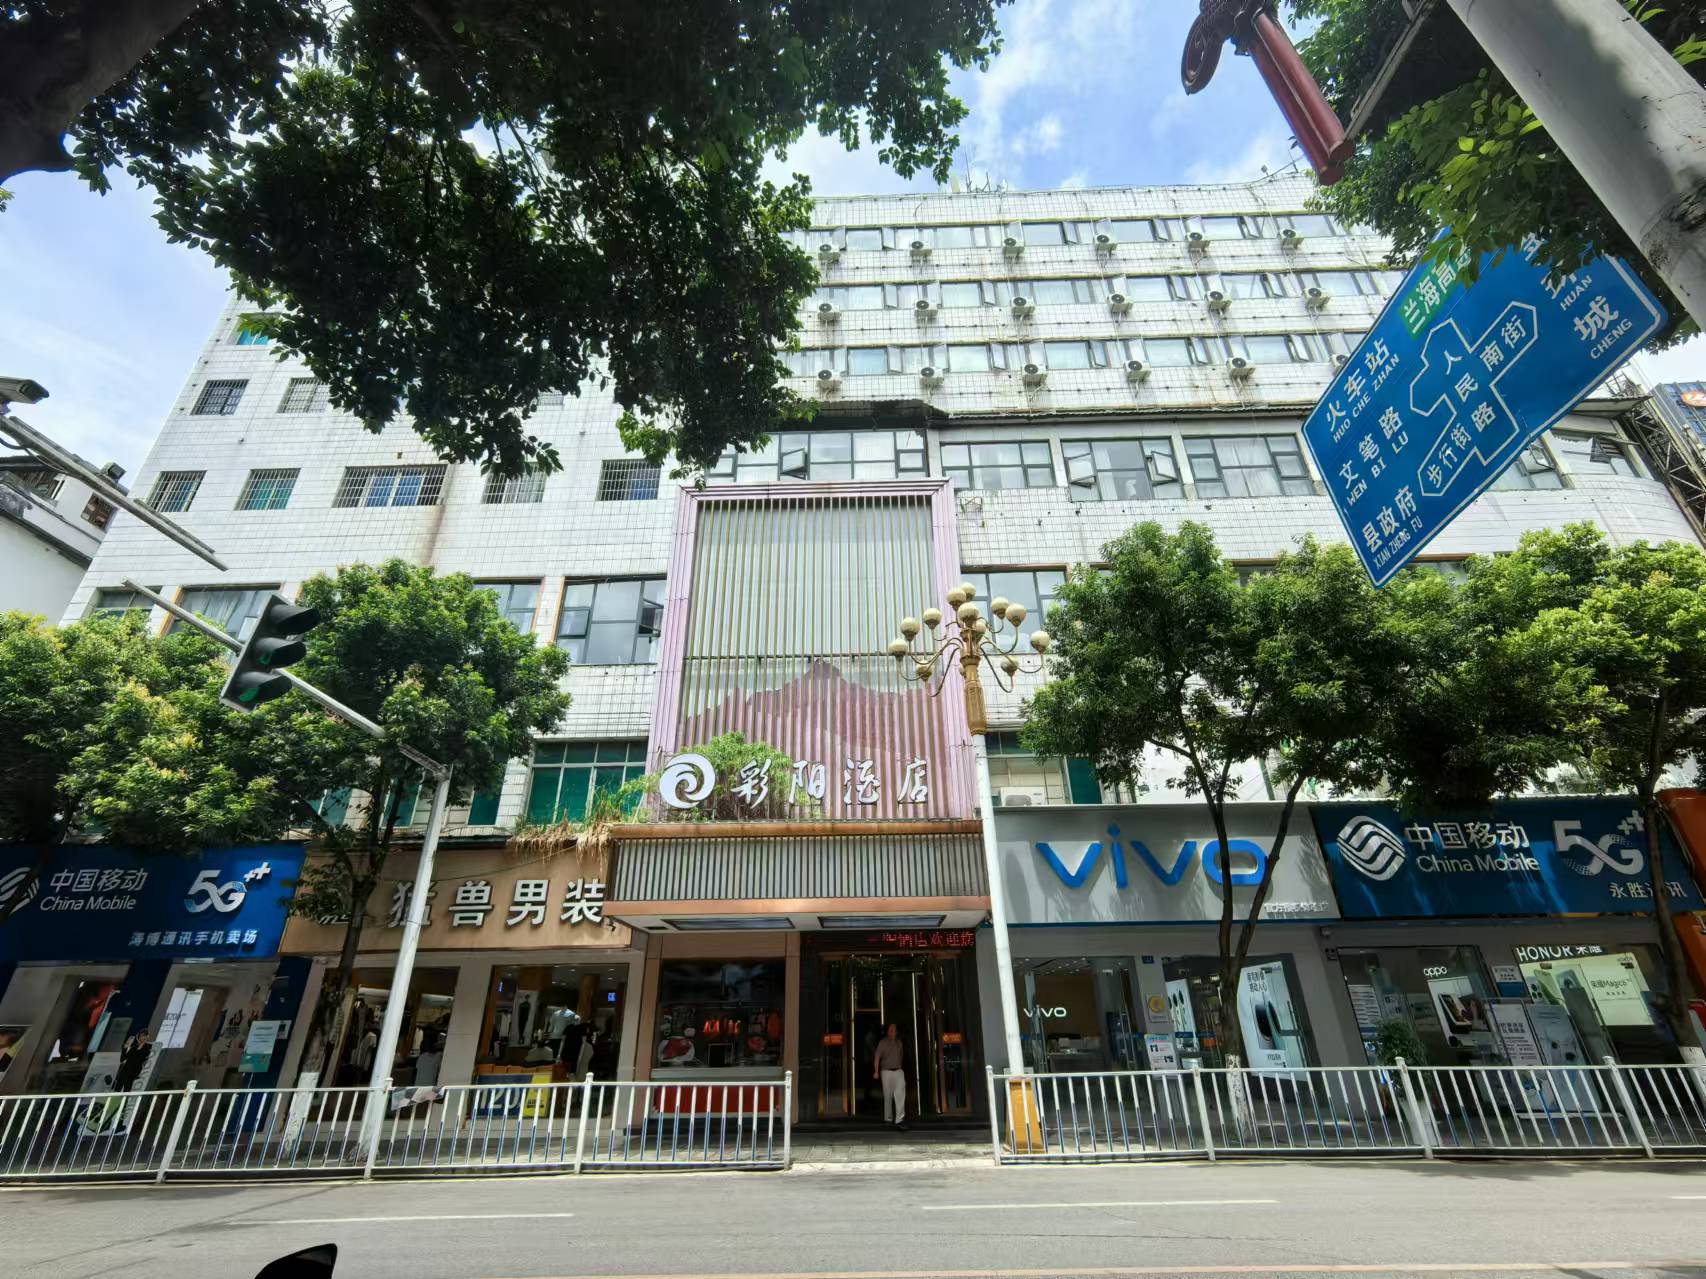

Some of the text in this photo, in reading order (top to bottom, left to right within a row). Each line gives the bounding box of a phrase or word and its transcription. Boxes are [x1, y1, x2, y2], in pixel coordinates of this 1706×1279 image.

[1560, 275, 1593, 311] HUAN
[1480, 315, 1527, 372] 南街
[1590, 318, 1633, 359] CHENG
[1326, 338, 1390, 432] 火车站
[1333, 353, 1400, 443] HUO CHE ZHAN
[1444, 350, 1496, 433] 人民路
[1338, 405, 1403, 490] 文笔路
[1346, 431, 1409, 506] WEN BI LU
[1427, 422, 1472, 488] 步行街
[1362, 484, 1417, 553] 县政府
[1373, 515, 1424, 571] XIAN ZHENG FU
[731, 757, 929, 809] 彩阳酒店
[1034, 823, 1270, 889] vivo
[1404, 819, 1531, 851] 中国移动
[49, 868, 149, 893] 中国移动
[1415, 852, 1541, 873] China Mobile
[40, 894, 137, 911] China Mobile
[388, 878, 607, 928] 猛兽男装
[1516, 946, 1574, 962] HONOR
[1023, 1004, 1067, 1018] vivo
